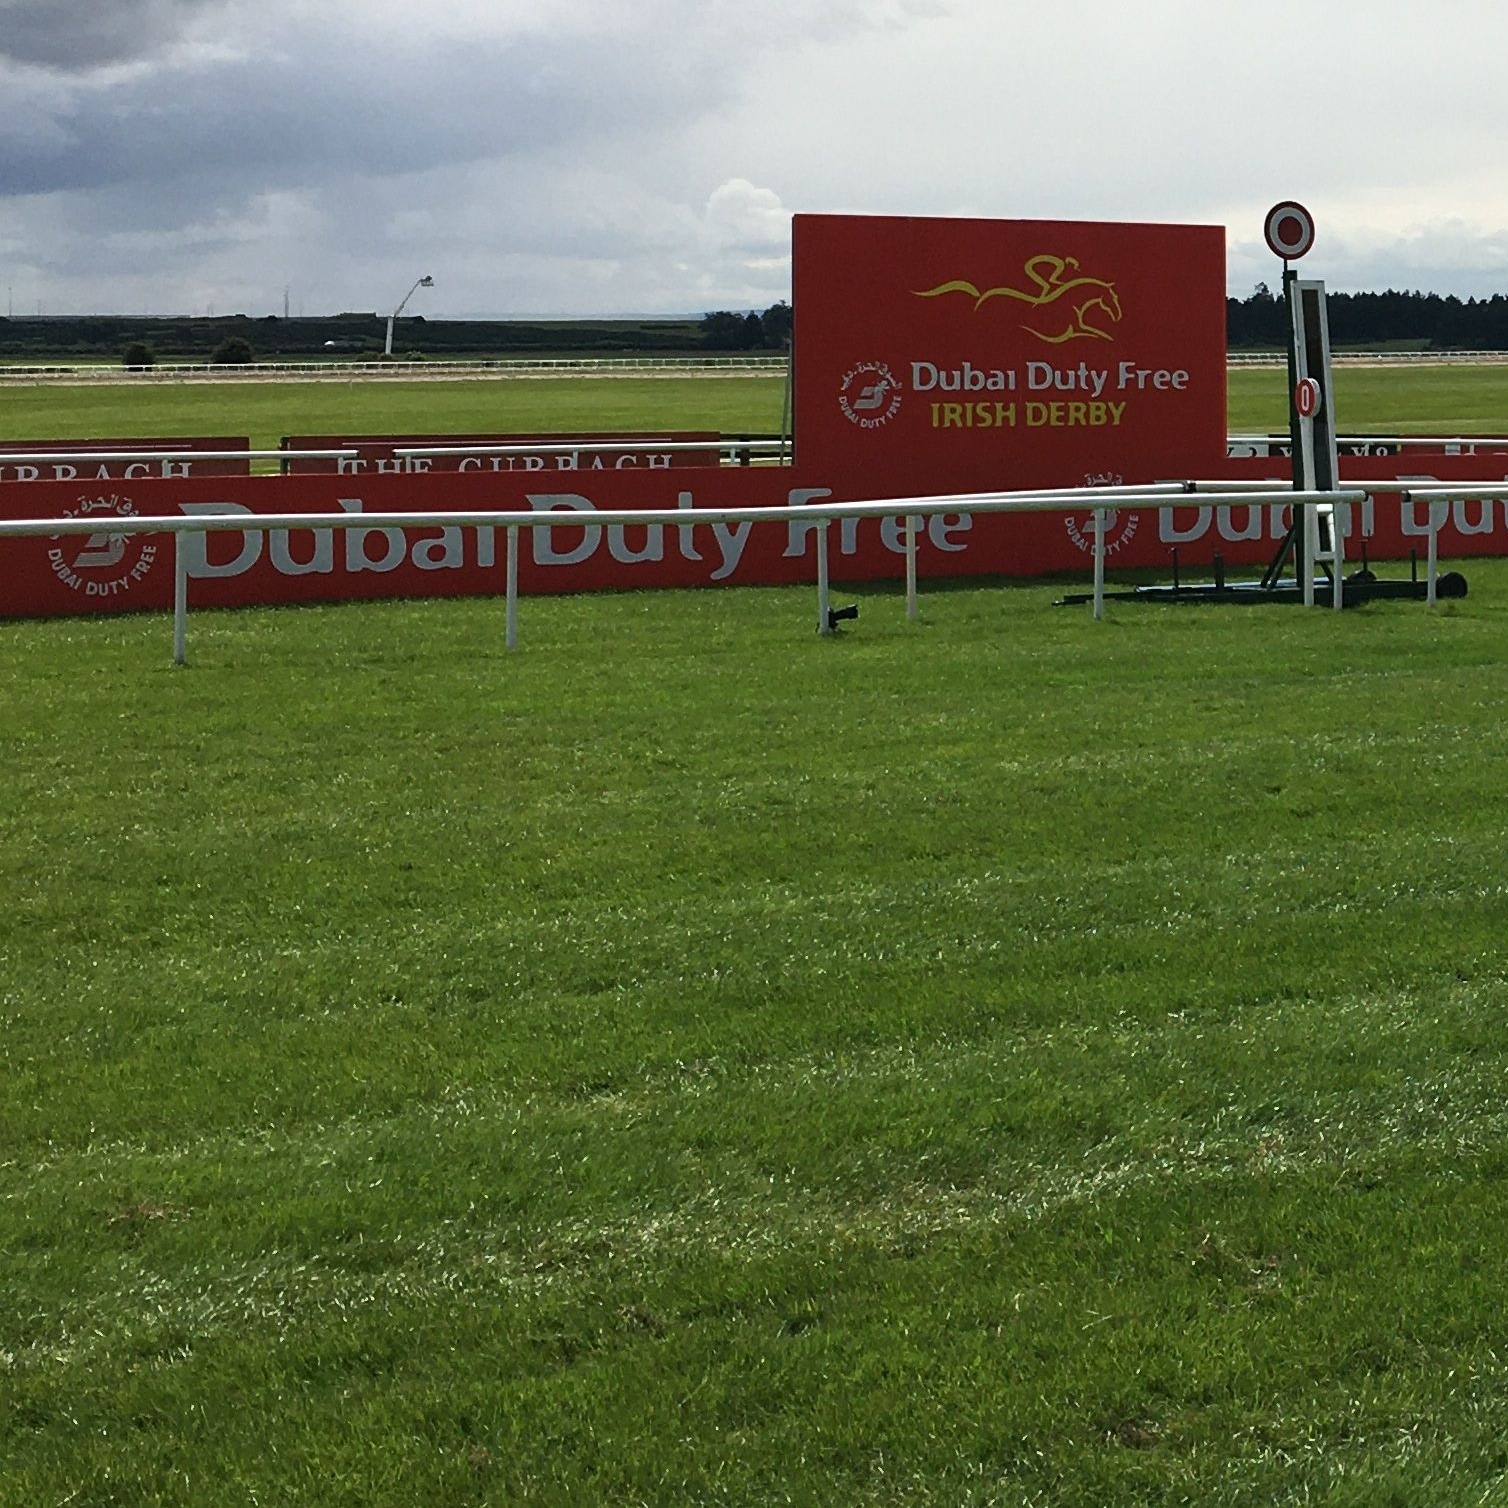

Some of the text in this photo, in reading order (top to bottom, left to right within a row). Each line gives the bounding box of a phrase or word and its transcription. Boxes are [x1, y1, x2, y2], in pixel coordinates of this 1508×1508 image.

[910, 361, 1191, 398] Dubai Duty Free
[860, 415, 887, 429] DUTY
[930, 401, 1127, 428] IRISH DERBY
[178, 498, 496, 579] Dubai
[525, 491, 755, 581] Duty
[782, 487, 974, 558] Free
[1064, 514, 1139, 556] DUBAI DTY FREE
[48, 544, 157, 597] DUBAI DUTY FREE
